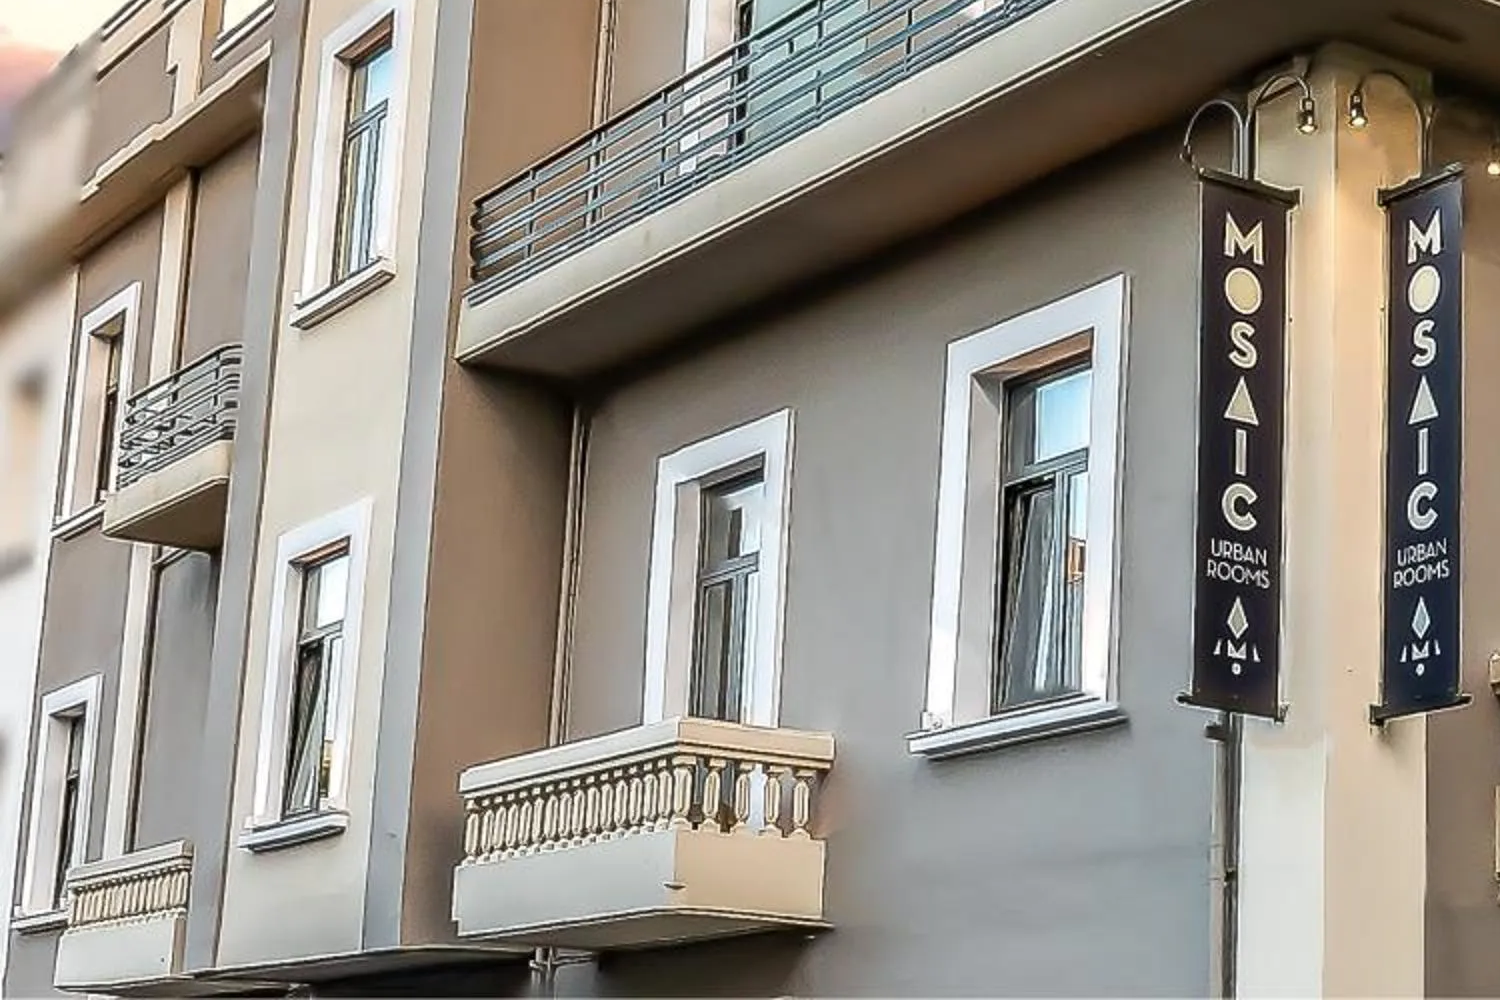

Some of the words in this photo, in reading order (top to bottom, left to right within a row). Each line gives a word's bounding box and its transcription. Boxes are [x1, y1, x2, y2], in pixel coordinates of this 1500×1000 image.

[1222, 210, 1264, 530] MOSAIC
[1407, 209, 1443, 530] MOSAIC
[1211, 538, 1268, 566] URBAN
[1397, 538, 1448, 566] URBAN
[1207, 561, 1270, 589] ROOMS
[1393, 560, 1450, 588] ROOMS
